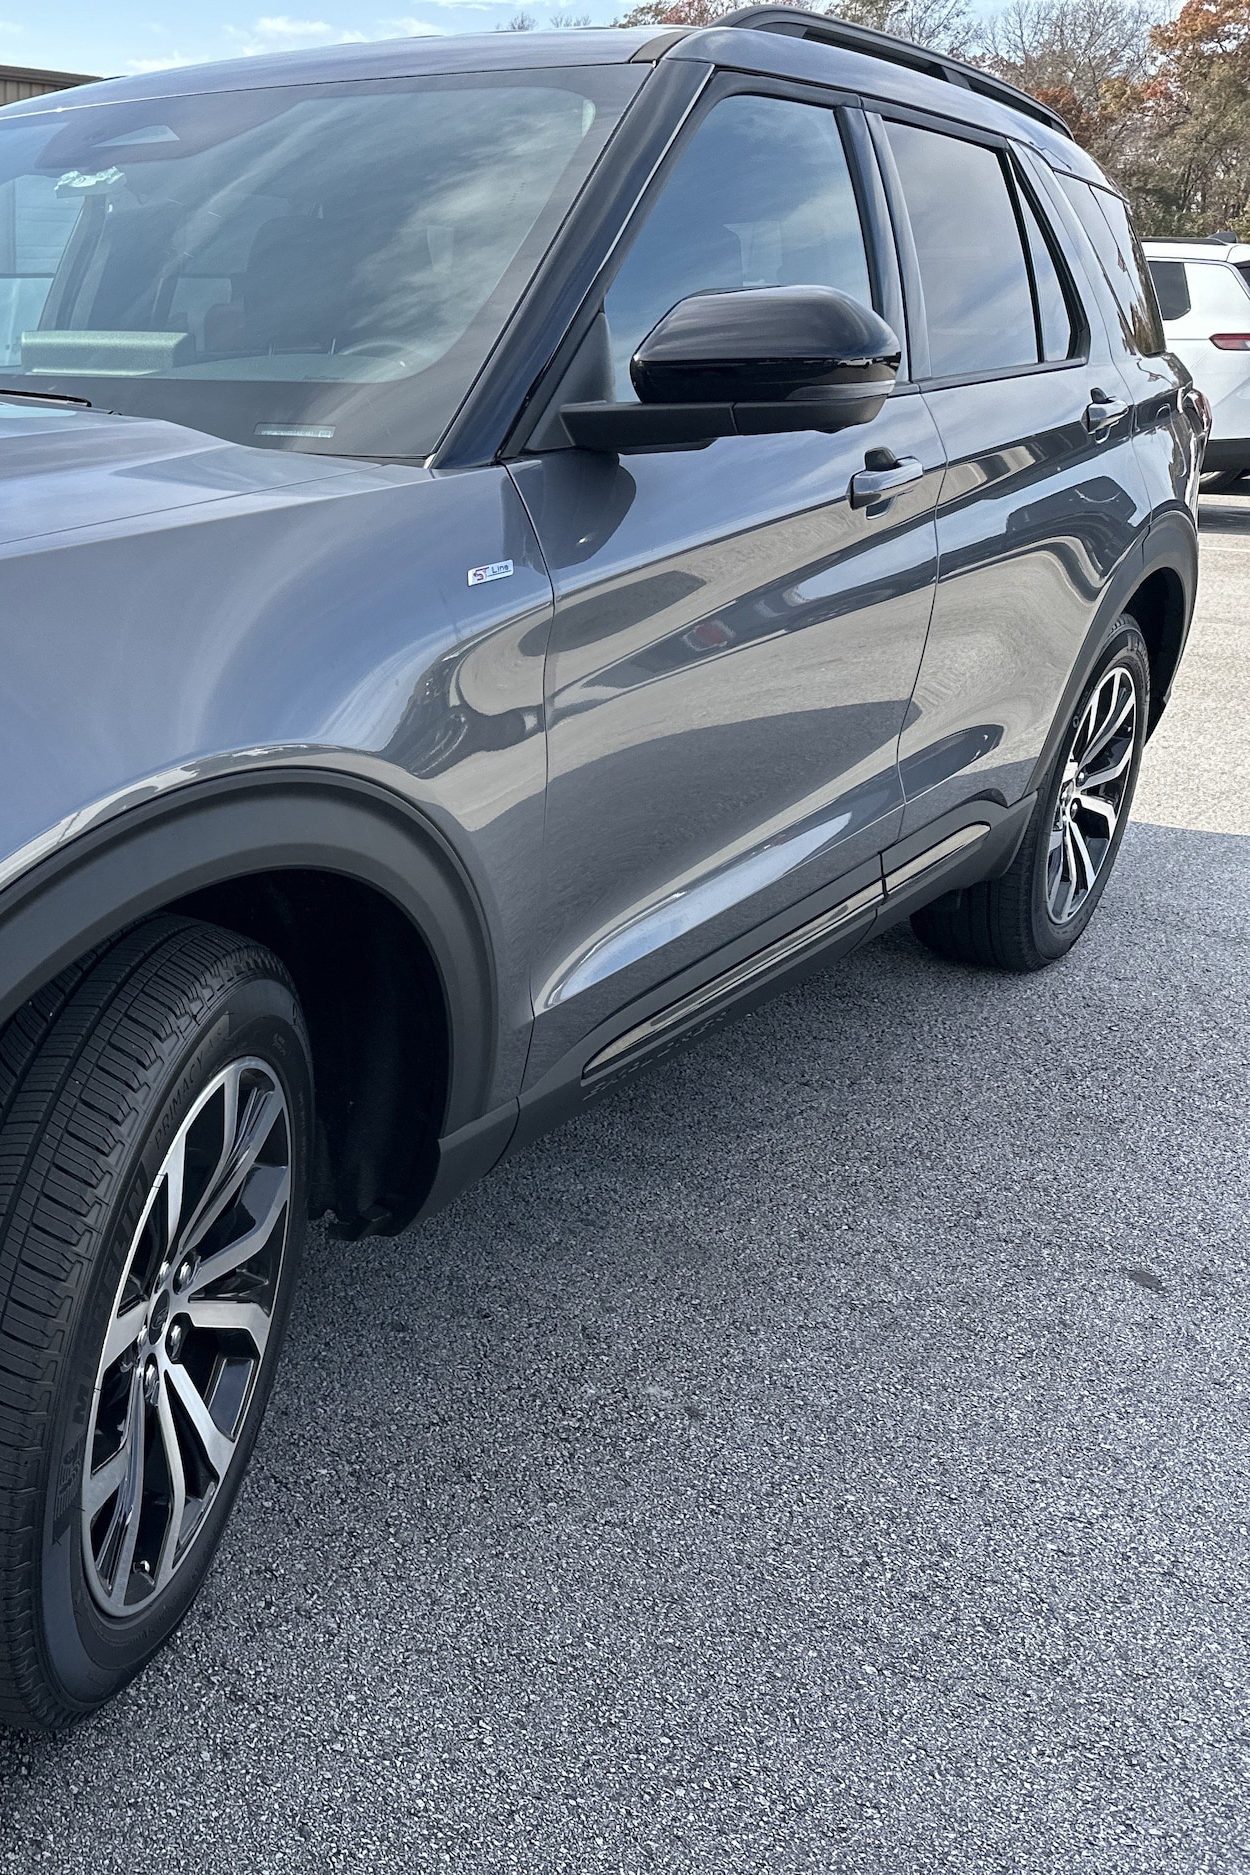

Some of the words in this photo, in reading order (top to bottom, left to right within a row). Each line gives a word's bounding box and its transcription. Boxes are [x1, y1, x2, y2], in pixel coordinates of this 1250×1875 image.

[473, 566, 490, 581] ST
[492, 564, 510, 574] Line
[154, 1050, 204, 1150] PRIMACY
